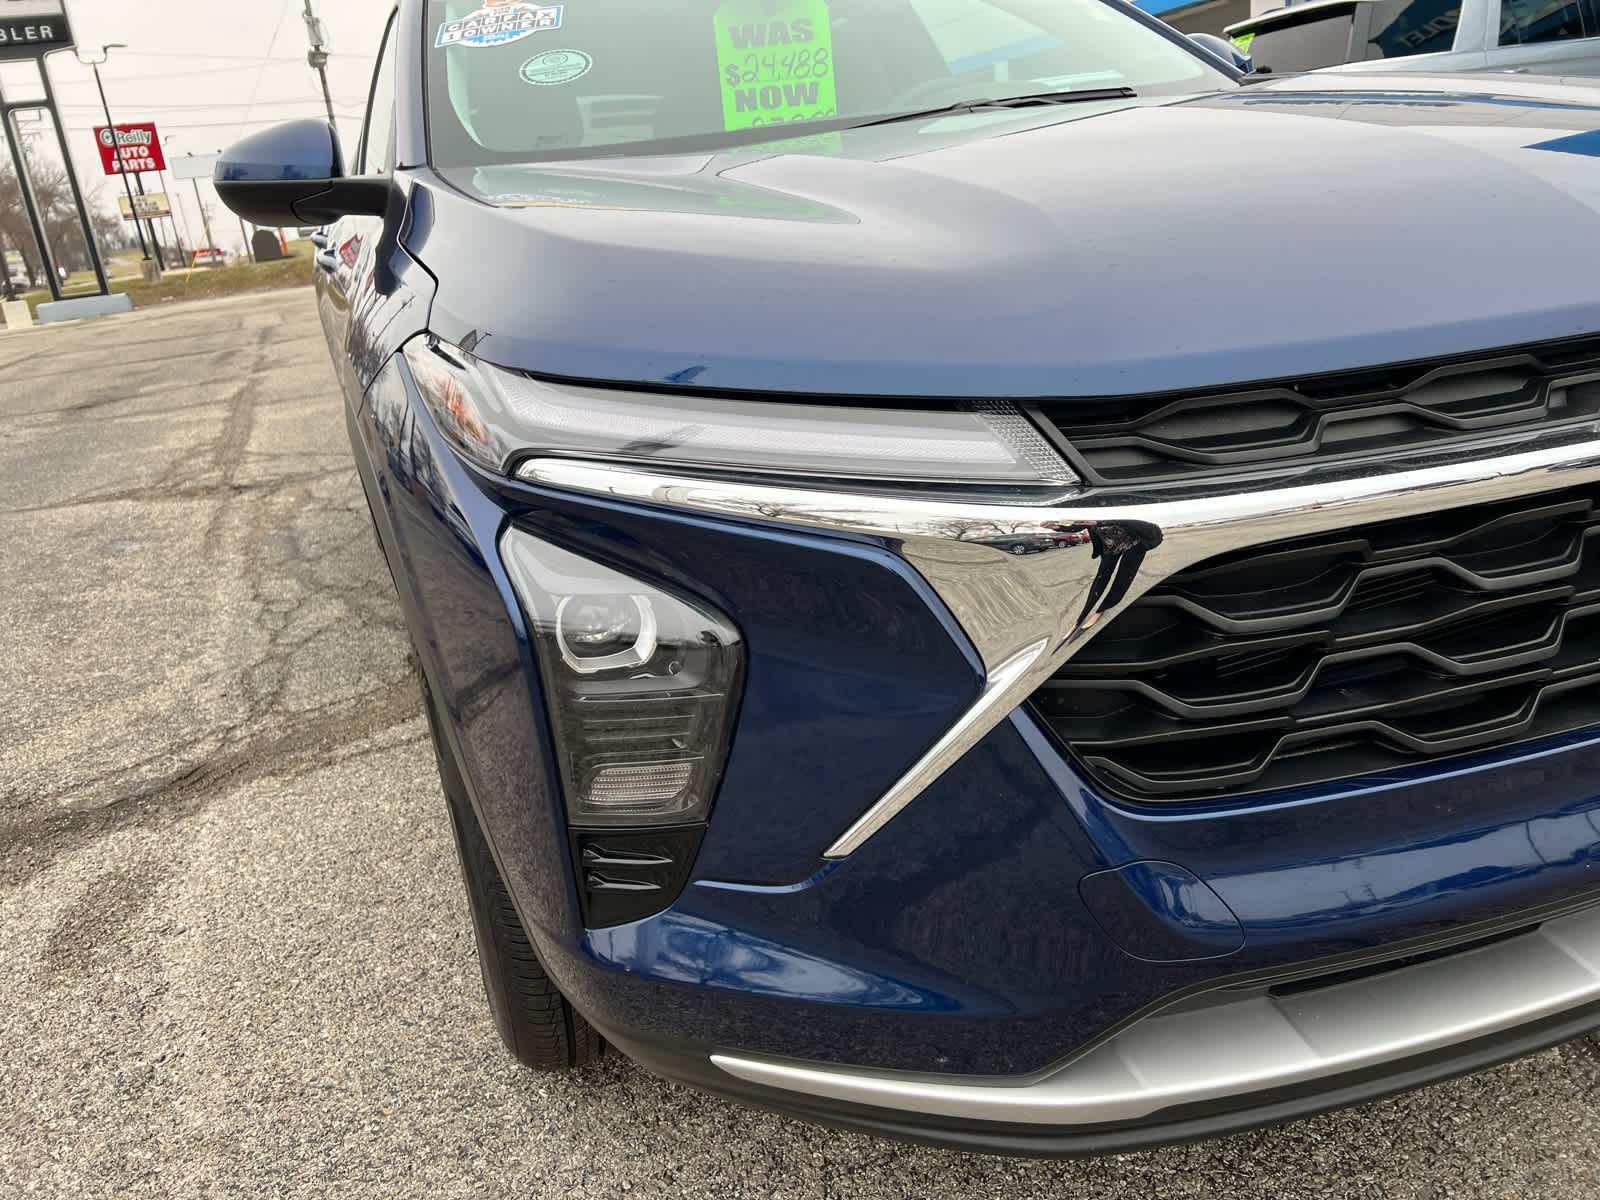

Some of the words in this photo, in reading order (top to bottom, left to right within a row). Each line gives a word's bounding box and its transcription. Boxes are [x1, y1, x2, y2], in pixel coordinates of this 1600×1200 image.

[446, 10, 554, 32] CARFAX
[463, 18, 555, 38] OWNER
[728, 18, 814, 49] WAS
[735, 81, 819, 113] NOW
[100, 128, 152, 145] OReilly
[112, 157, 155, 172] PARTS
